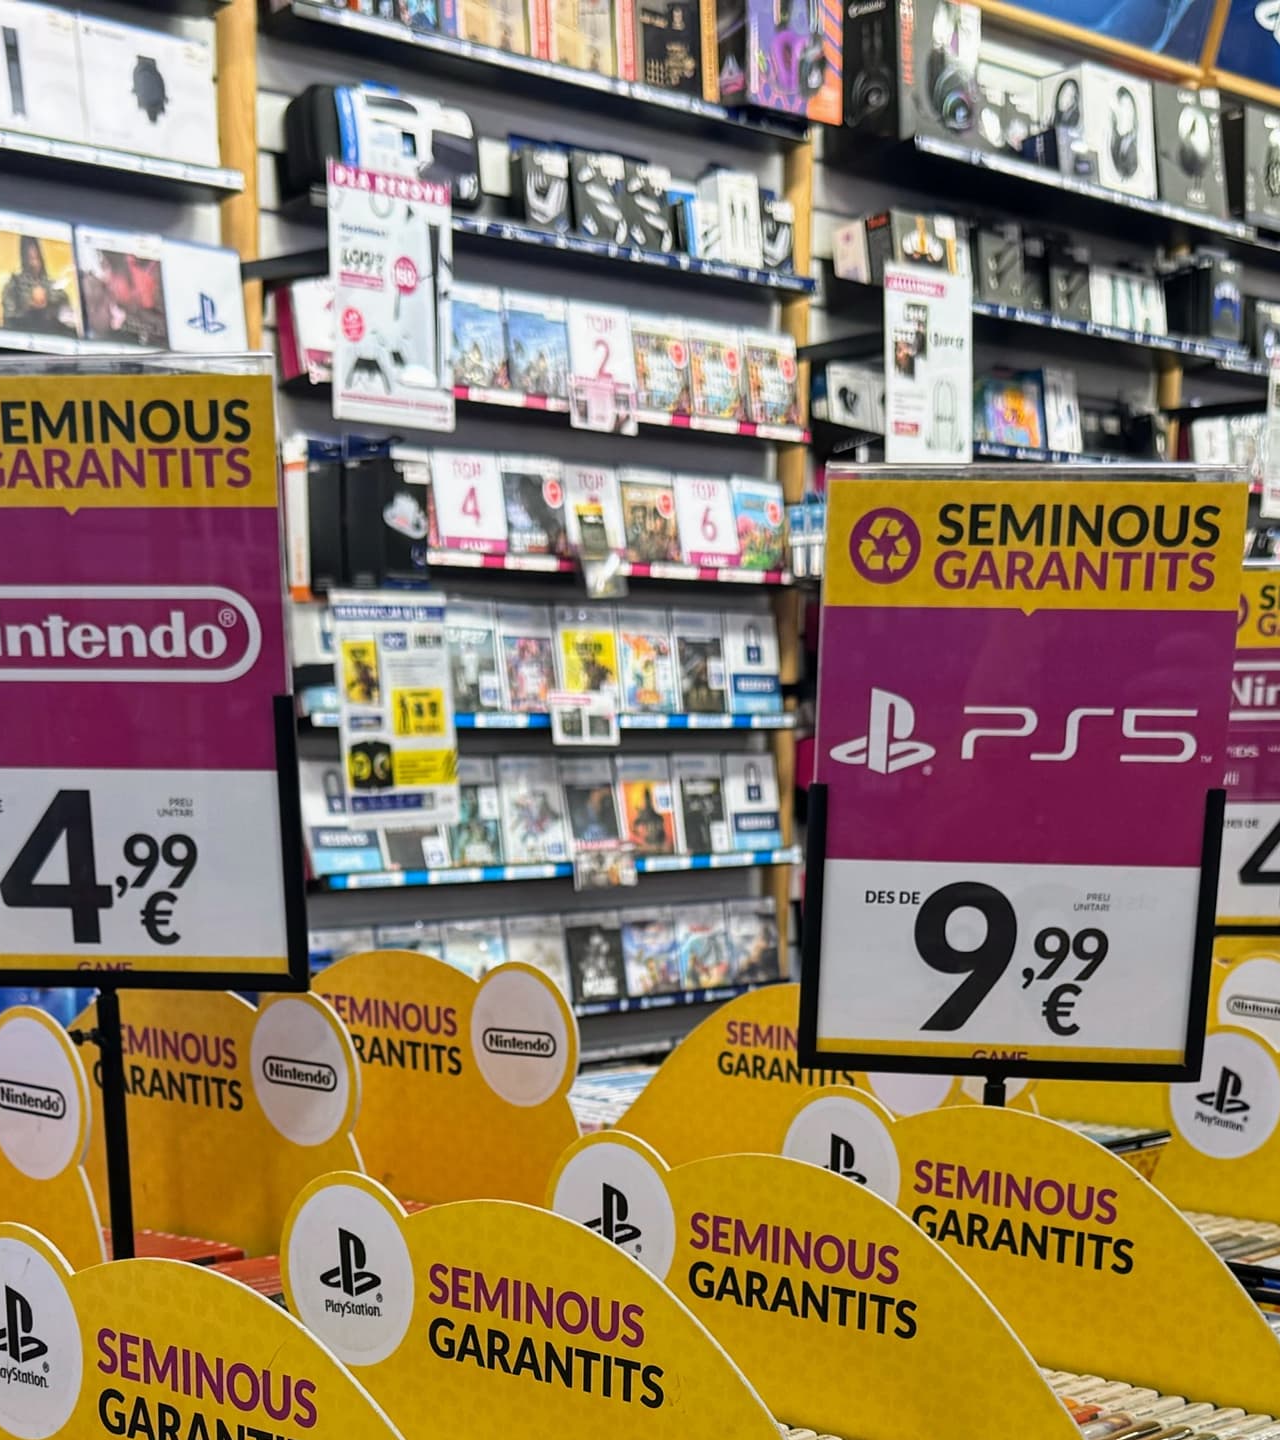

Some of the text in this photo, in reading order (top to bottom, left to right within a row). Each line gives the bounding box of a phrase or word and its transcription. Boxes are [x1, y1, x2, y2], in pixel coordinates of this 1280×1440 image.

[937, 503, 1221, 549] SEMINOUS
[933, 551, 1216, 593] GARANTITS
[960, 705, 1198, 764] PS5
[322, 993, 458, 1037] SEMINOUS
[489, 1033, 552, 1054] Nintendo
[269, 1063, 331, 1087] Nintendo
[1194, 1107, 1245, 1134] PlayStation
[913, 1159, 1118, 1225] SEMINOUS
[689, 1213, 899, 1285] SEMINOUS
[912, 1205, 1135, 1276] GARANTITS
[324, 1299, 381, 1318] PlayStation
[428, 1263, 644, 1349] SEMINOUS
[688, 1260, 918, 1340] GARANTITS
[98, 1328, 318, 1429] SEMINOUS
[428, 1317, 665, 1409] GARANTITS
